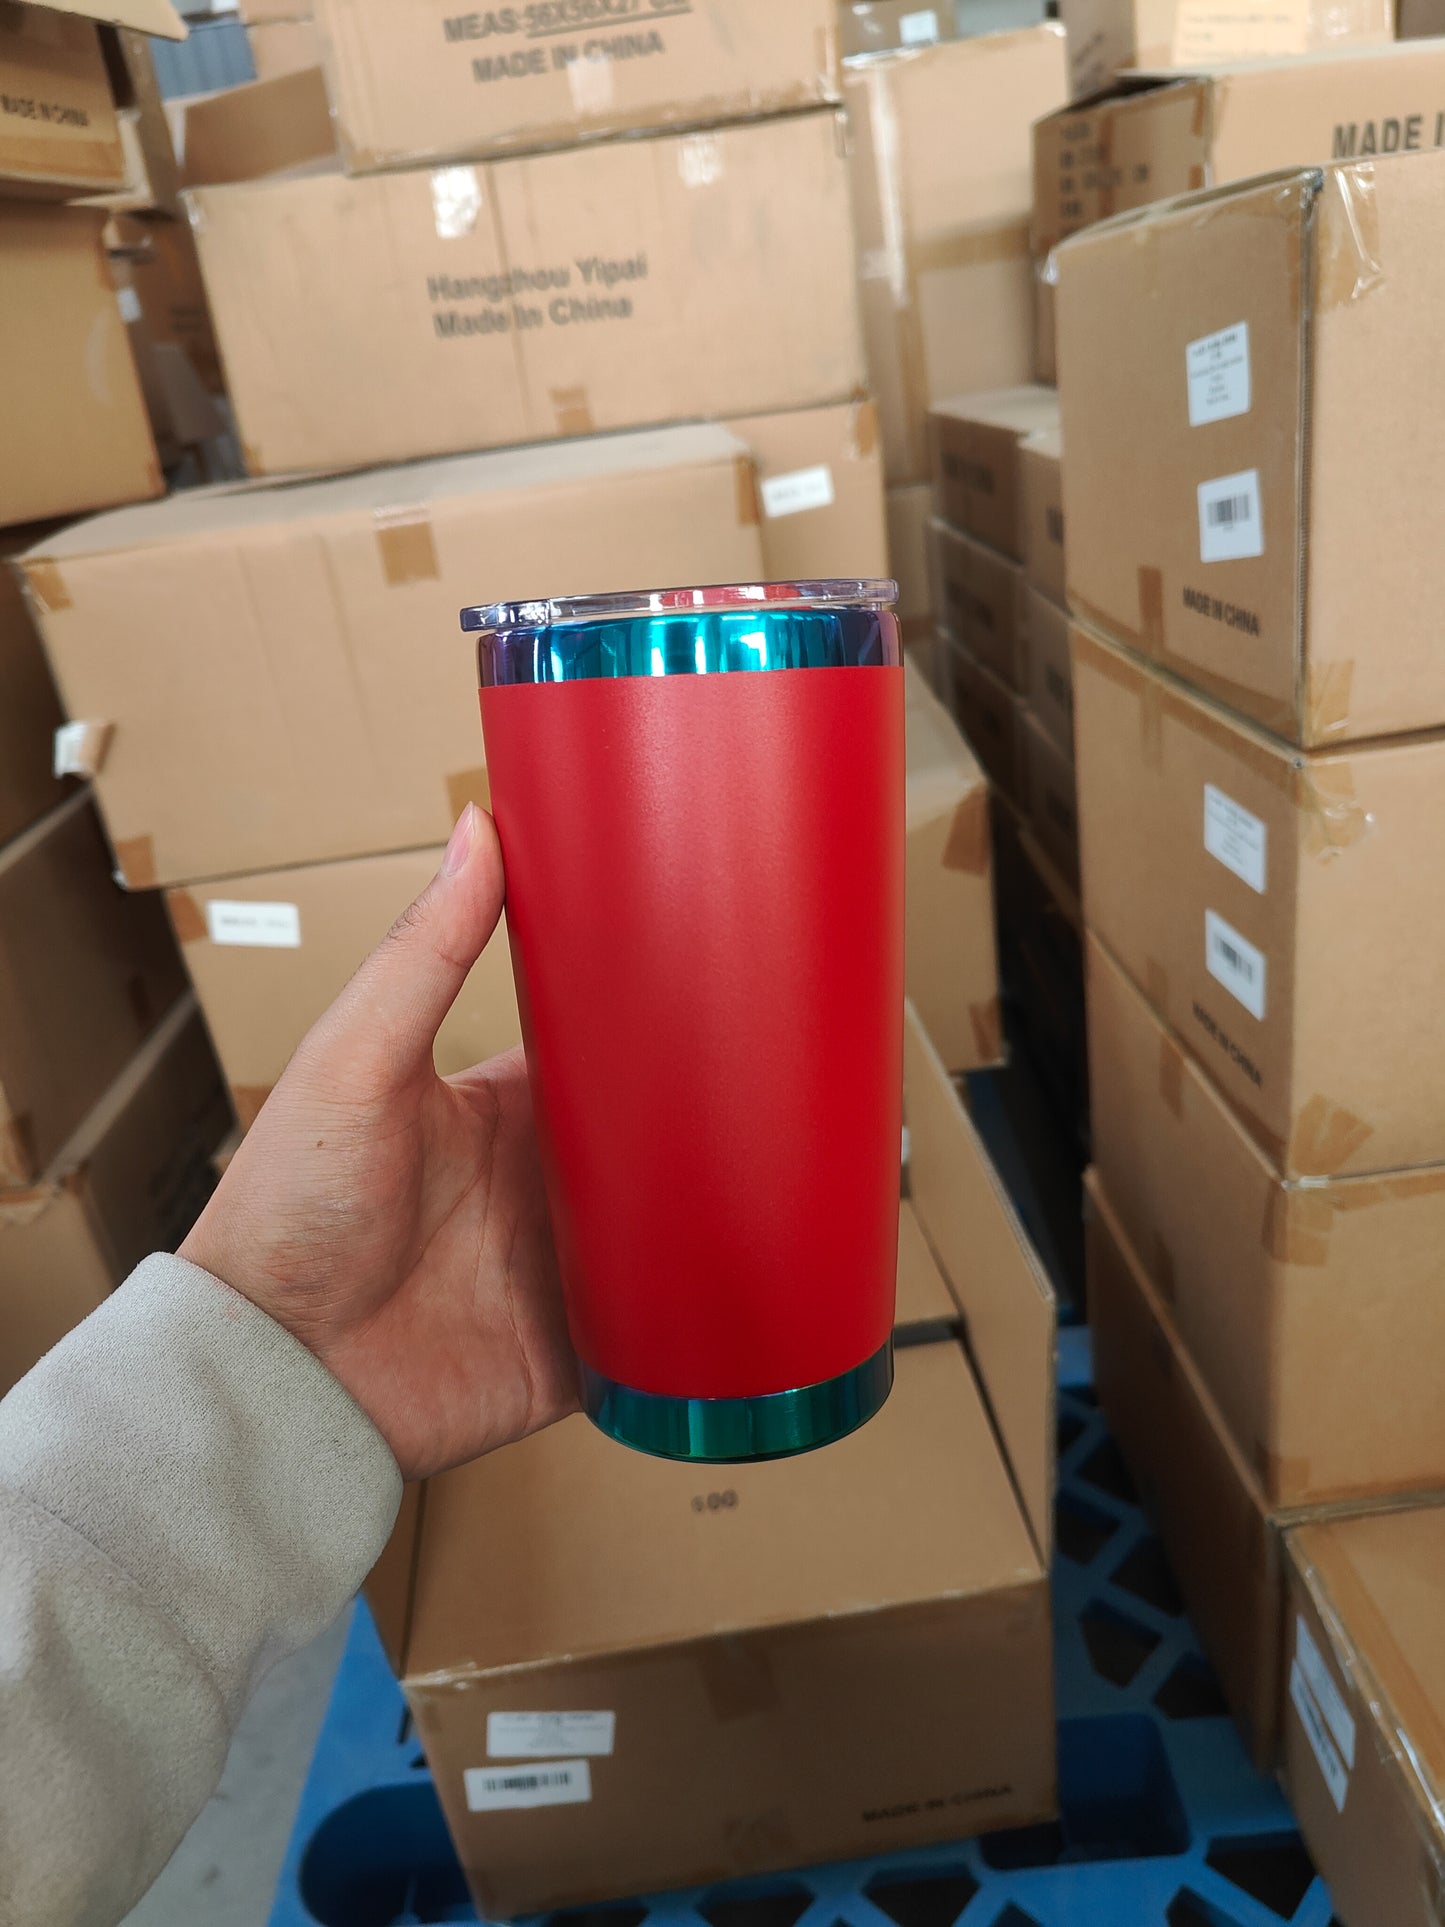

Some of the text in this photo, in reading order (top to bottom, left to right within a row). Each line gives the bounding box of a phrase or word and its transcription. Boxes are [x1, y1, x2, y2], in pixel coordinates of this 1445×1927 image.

[471, 31, 666, 83] MADE IN CHINA
[1331, 111, 1445, 159] MADE I
[427, 267, 571, 304] Hangzhou
[432, 308, 510, 339] Made
[548, 294, 634, 325] China
[1183, 587, 1260, 637] MADE IN CHINA
